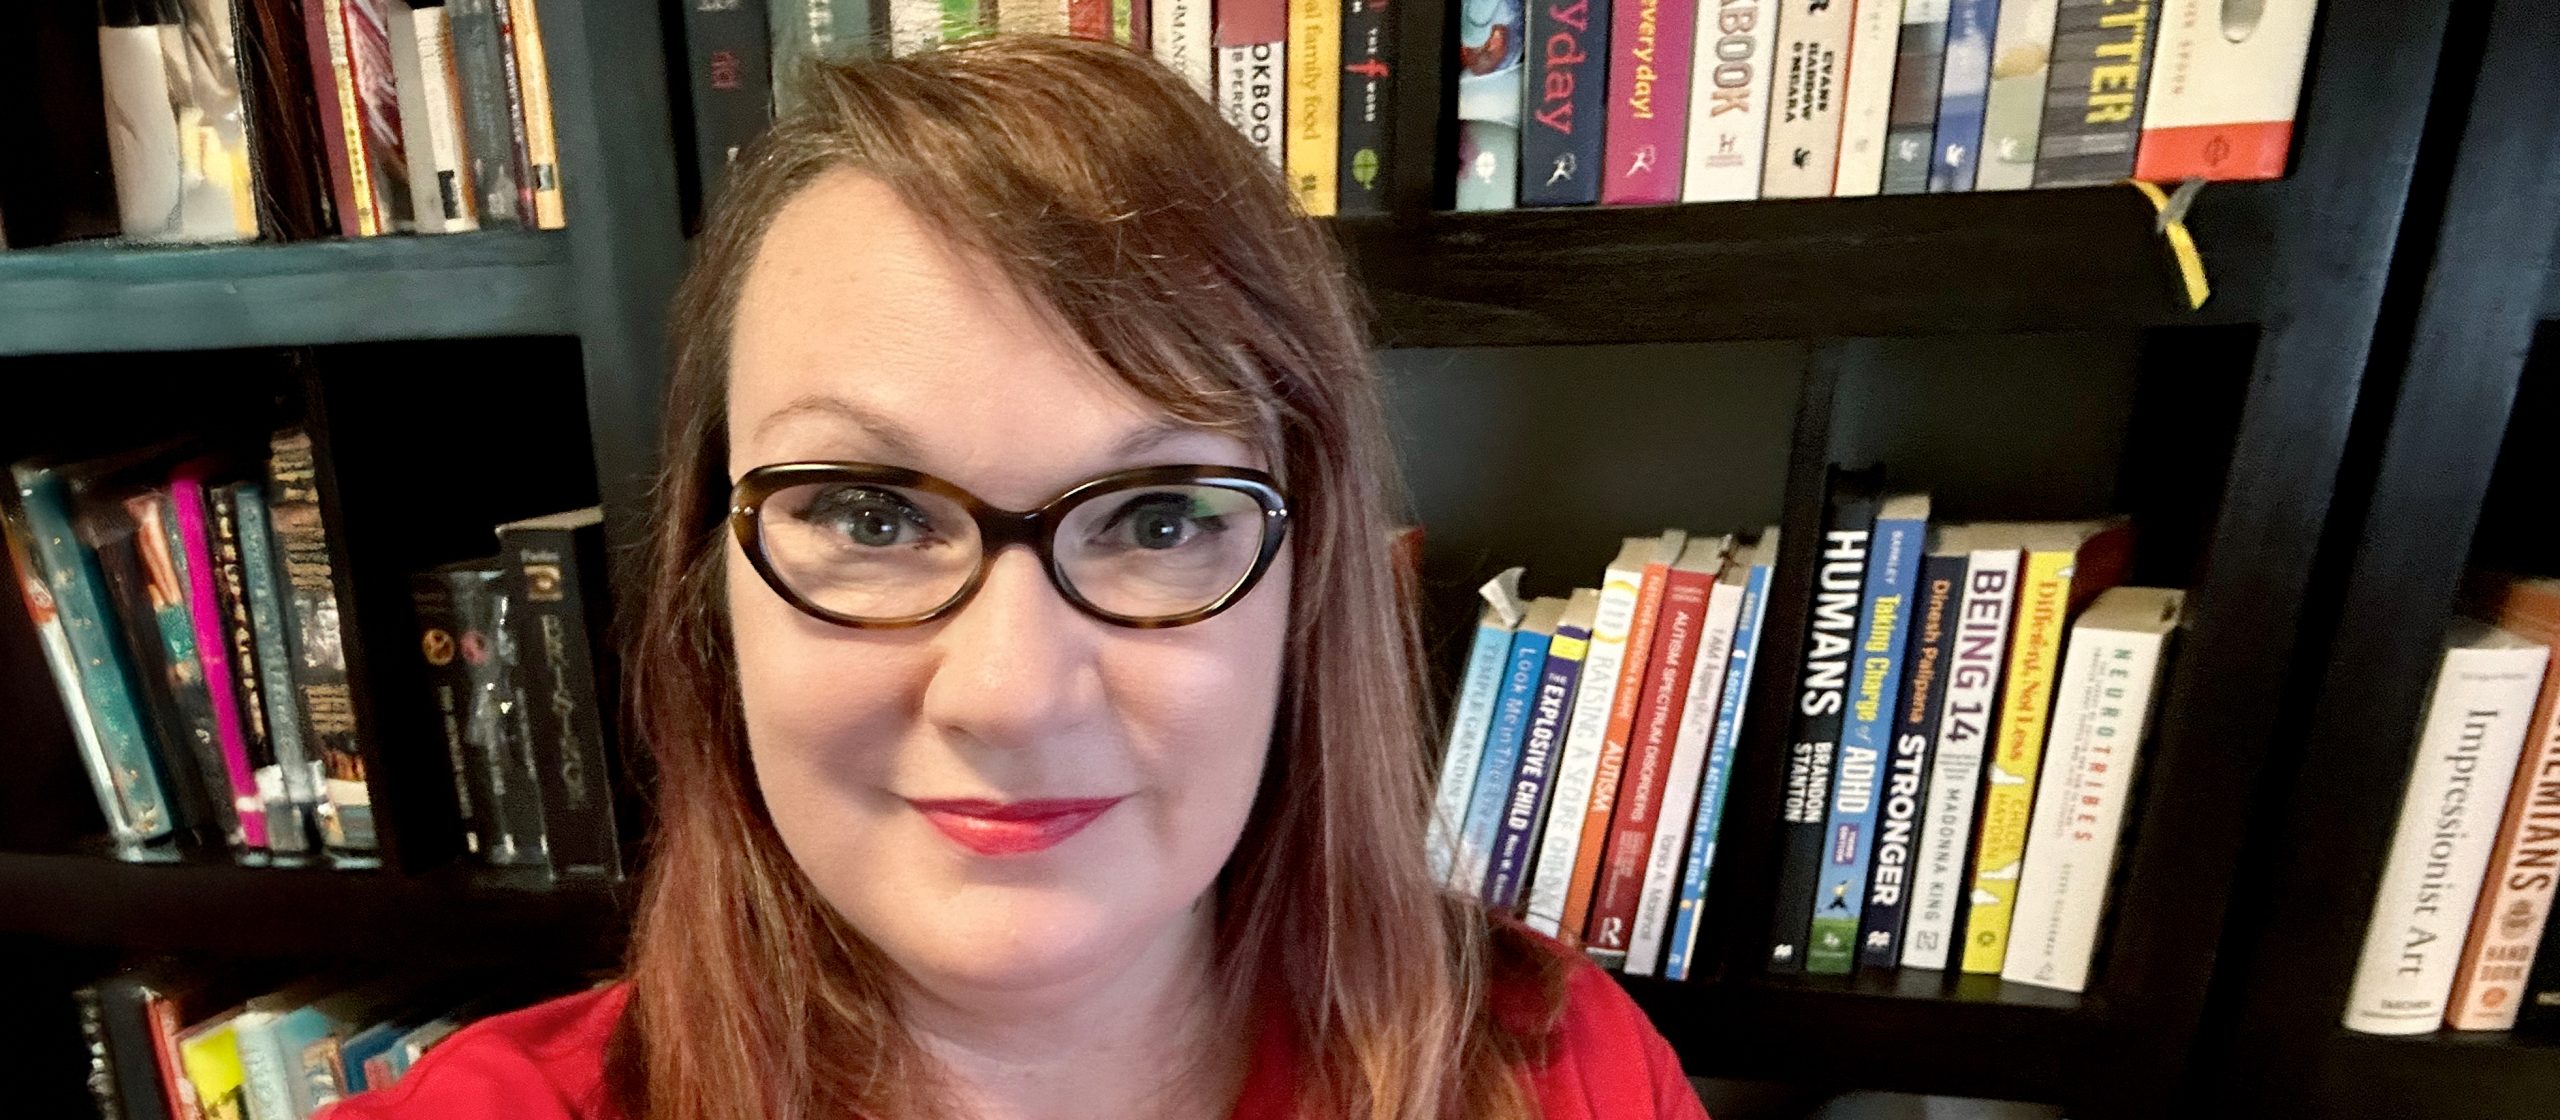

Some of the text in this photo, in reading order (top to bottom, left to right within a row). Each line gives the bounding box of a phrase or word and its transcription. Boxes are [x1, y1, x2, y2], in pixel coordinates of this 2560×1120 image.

[1303, 24, 1322, 91] family
[1710, 0, 1759, 118] BOOK
[2085, 0, 2148, 123] TTER
[1252, 43, 1271, 149] OKBOO
[1302, 95, 1321, 141] food
[1664, 610, 1690, 665] AUTISM
[1799, 530, 1868, 715] HUMANS
[1865, 594, 1901, 653] Taking
[1923, 578, 1951, 643] Dinesh
[1509, 645, 1537, 694] Look
[1720, 668, 1741, 715] SOCIAL
[1853, 655, 1889, 723] Charge
[1944, 568, 2007, 745] BEING 14
[1520, 682, 1565, 779] EXPLOSIVE
[1572, 654, 1616, 742] RAISING
[1647, 666, 1677, 743] SPECTRUM
[2017, 677, 2040, 713] Not
[1567, 744, 1593, 762] A
[1710, 719, 1731, 762] SKILLS
[2007, 715, 2032, 762] Less
[2072, 649, 2133, 842] NEUROTRIBES
[1506, 778, 1539, 832] CHILD
[1590, 738, 1625, 815] AUTISM
[1628, 744, 1660, 822] DISORDERS
[1696, 766, 1721, 833] ACTIVITIES
[1783, 742, 1813, 821] STANTON
[1802, 742, 1832, 823] BRANDON
[1835, 745, 1877, 815] ADHD
[2413, 709, 2499, 914] Impressionist
[1870, 734, 1926, 906] STRONGER
[1924, 787, 1960, 921] MADONNA KING
[2398, 924, 2437, 977] Art
